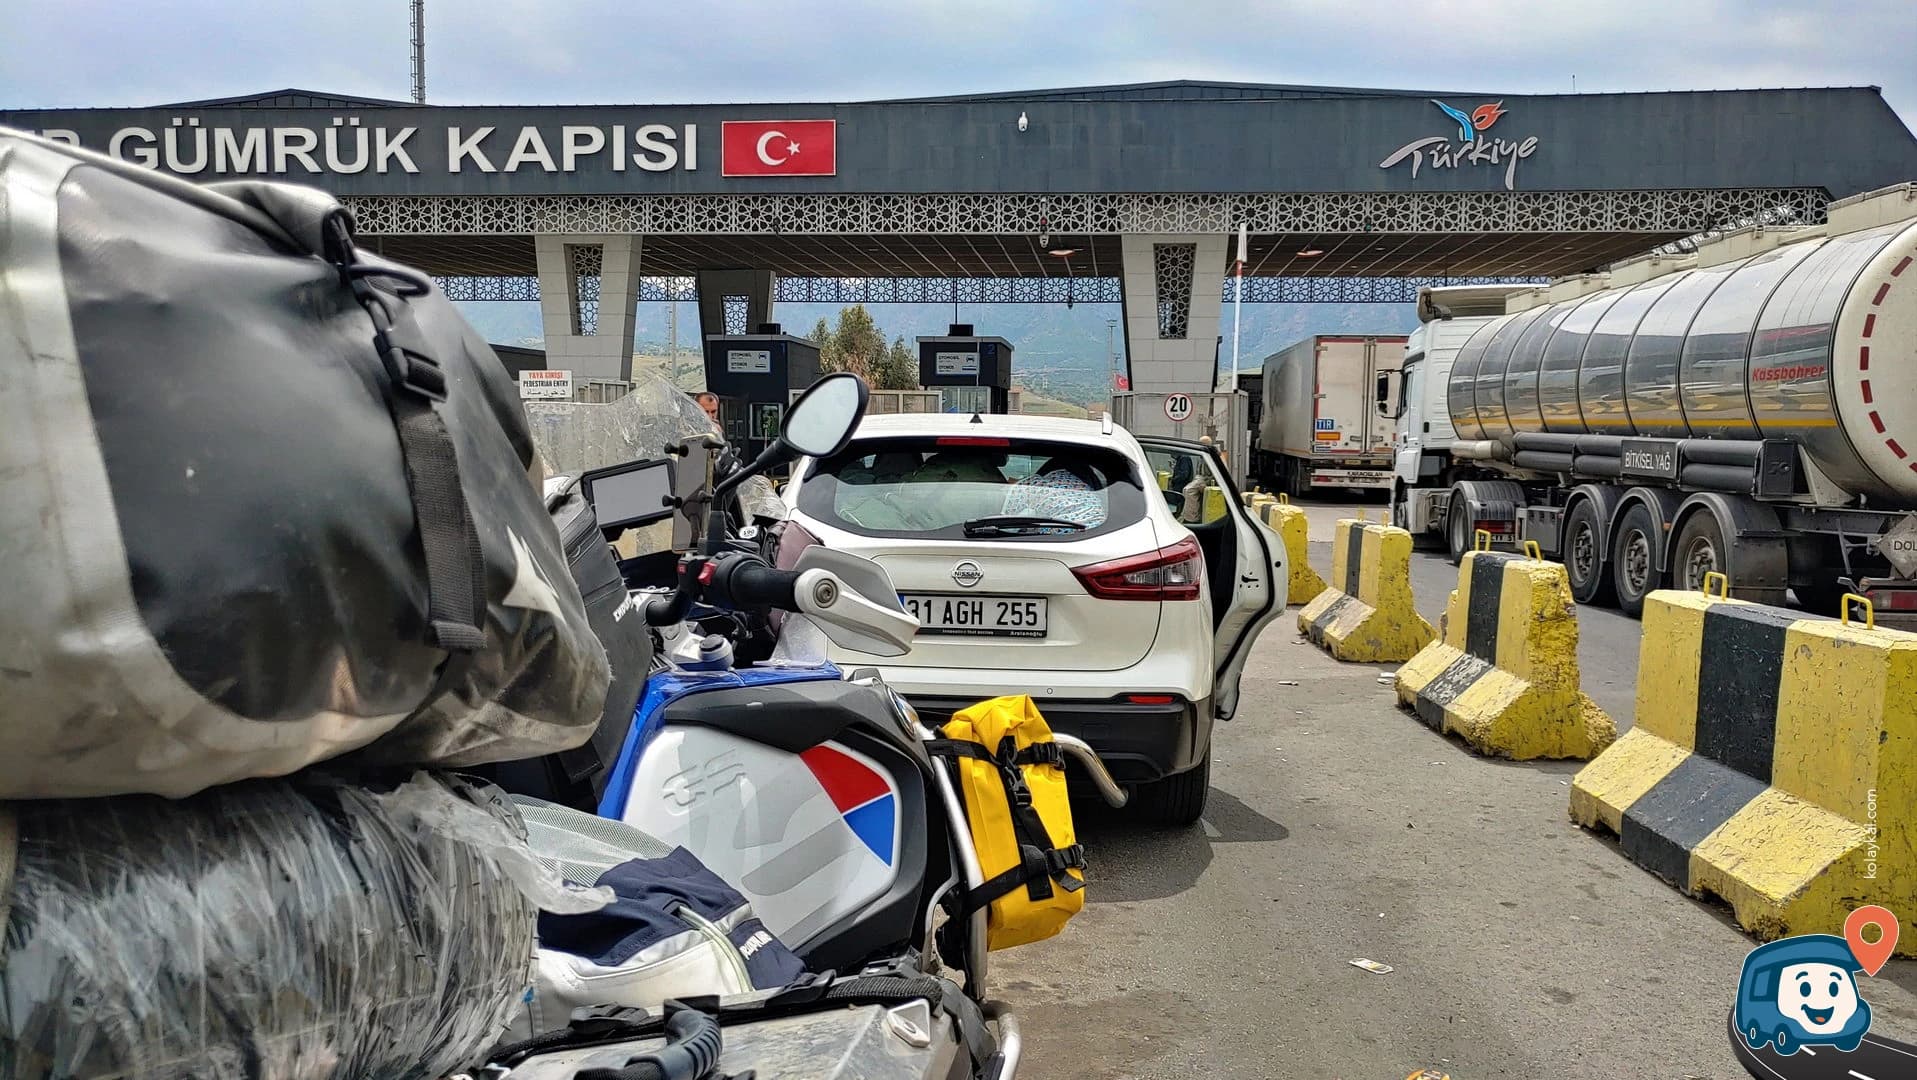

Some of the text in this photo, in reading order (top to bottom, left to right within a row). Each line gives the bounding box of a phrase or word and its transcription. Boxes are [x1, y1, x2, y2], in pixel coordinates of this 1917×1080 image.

[109, 117, 697, 173] GÜMRÜK KAPISI
[1379, 134, 1538, 190] Türkiye
[1170, 396, 1188, 412] 20
[1317, 420, 1334, 430] TIR
[1625, 450, 1671, 471] BİTKİSEL YAĞ
[907, 600, 1038, 626] 31 AGH 255
